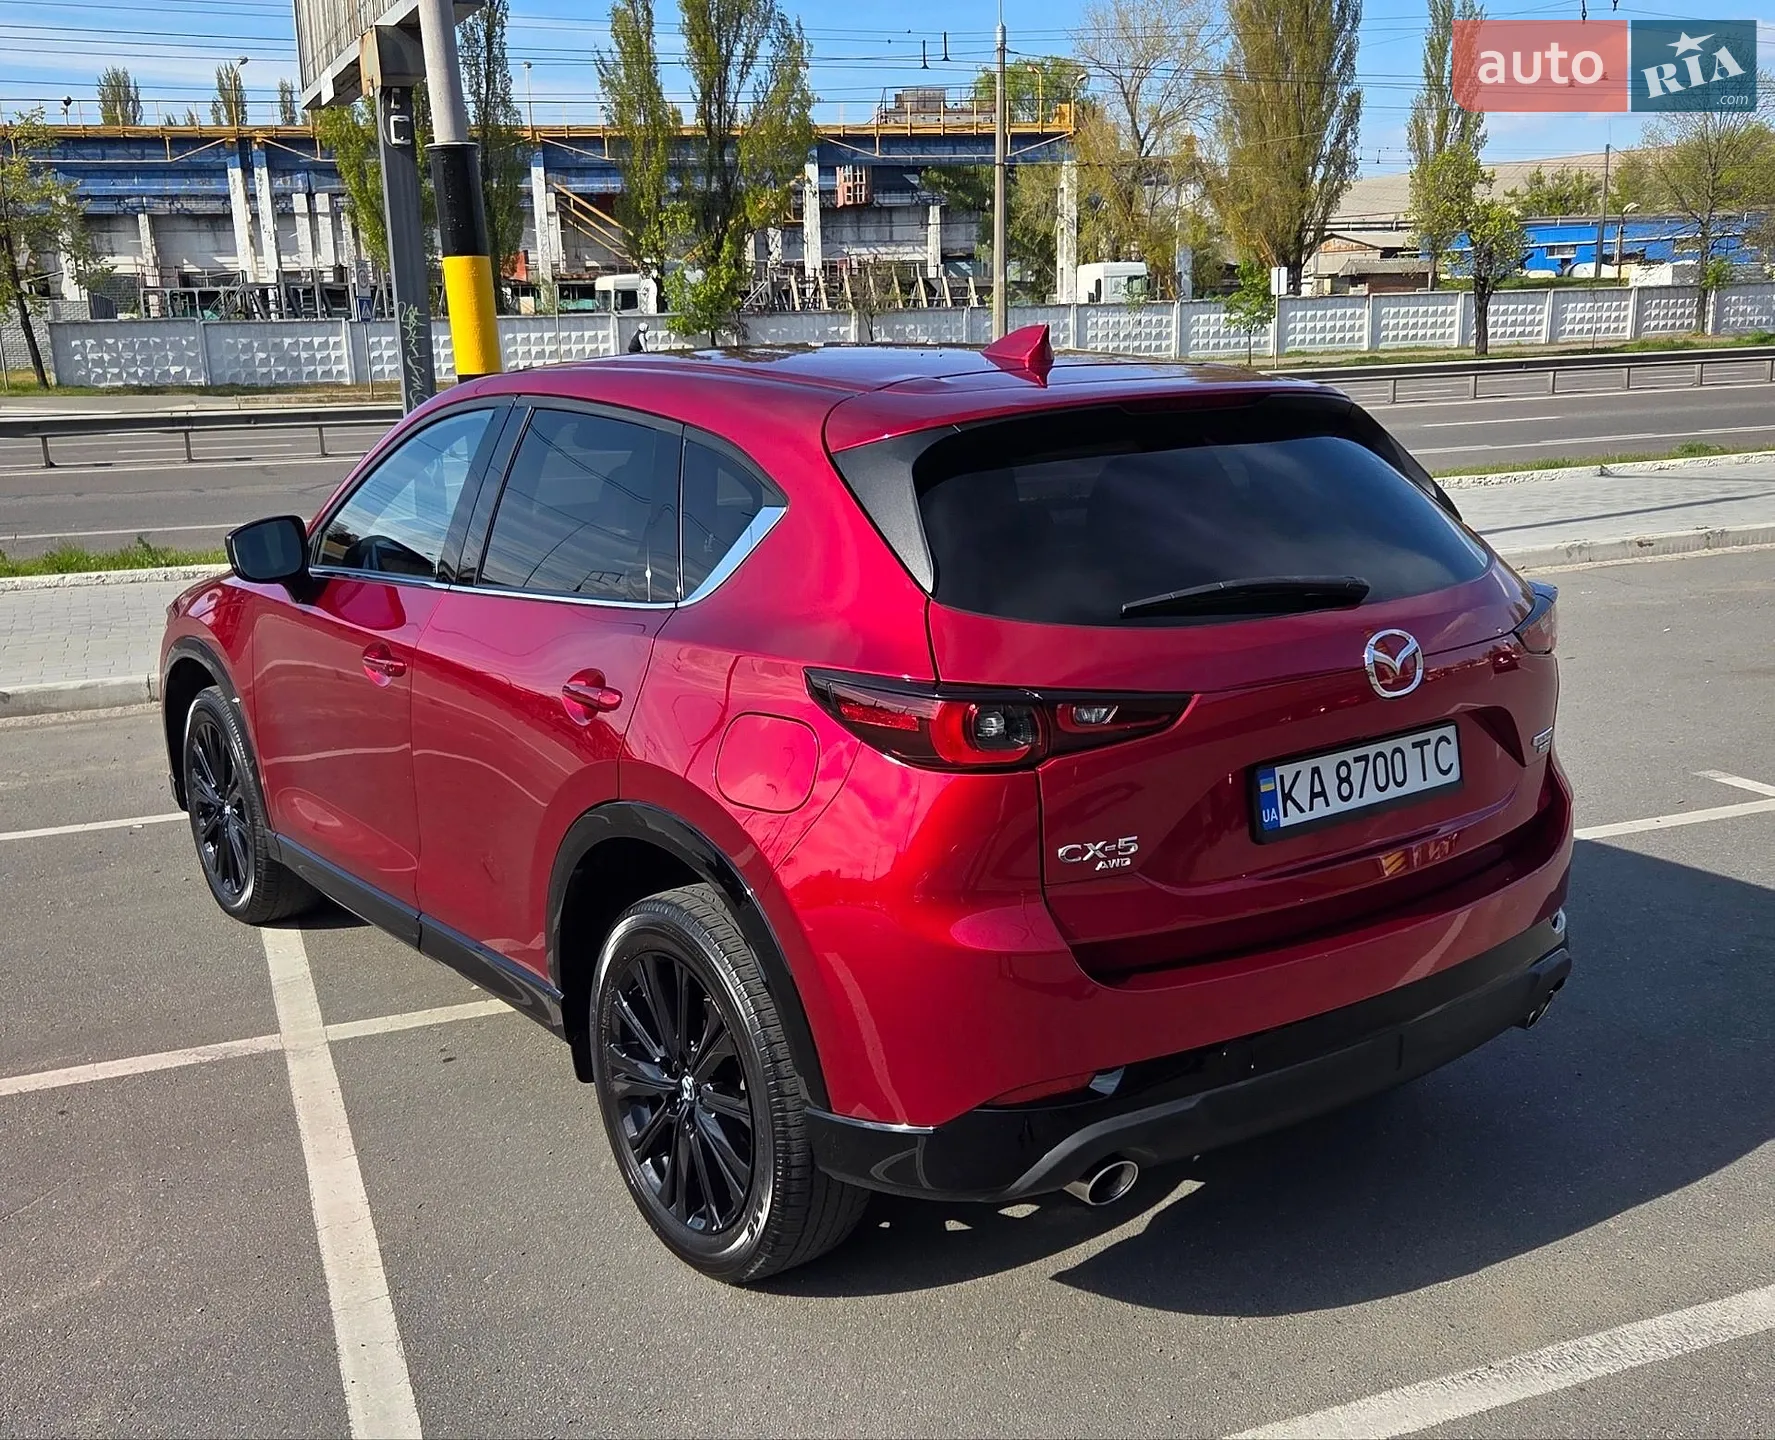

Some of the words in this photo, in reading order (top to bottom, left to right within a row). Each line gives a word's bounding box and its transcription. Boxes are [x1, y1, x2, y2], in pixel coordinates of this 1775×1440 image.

[1279, 766, 1330, 818] KA
[1336, 746, 1407, 802] 8700
[1411, 735, 1454, 782] TC
[1262, 807, 1279, 823] UA
[1057, 836, 1139, 863] CX-5
[1095, 857, 1131, 871] AWD
